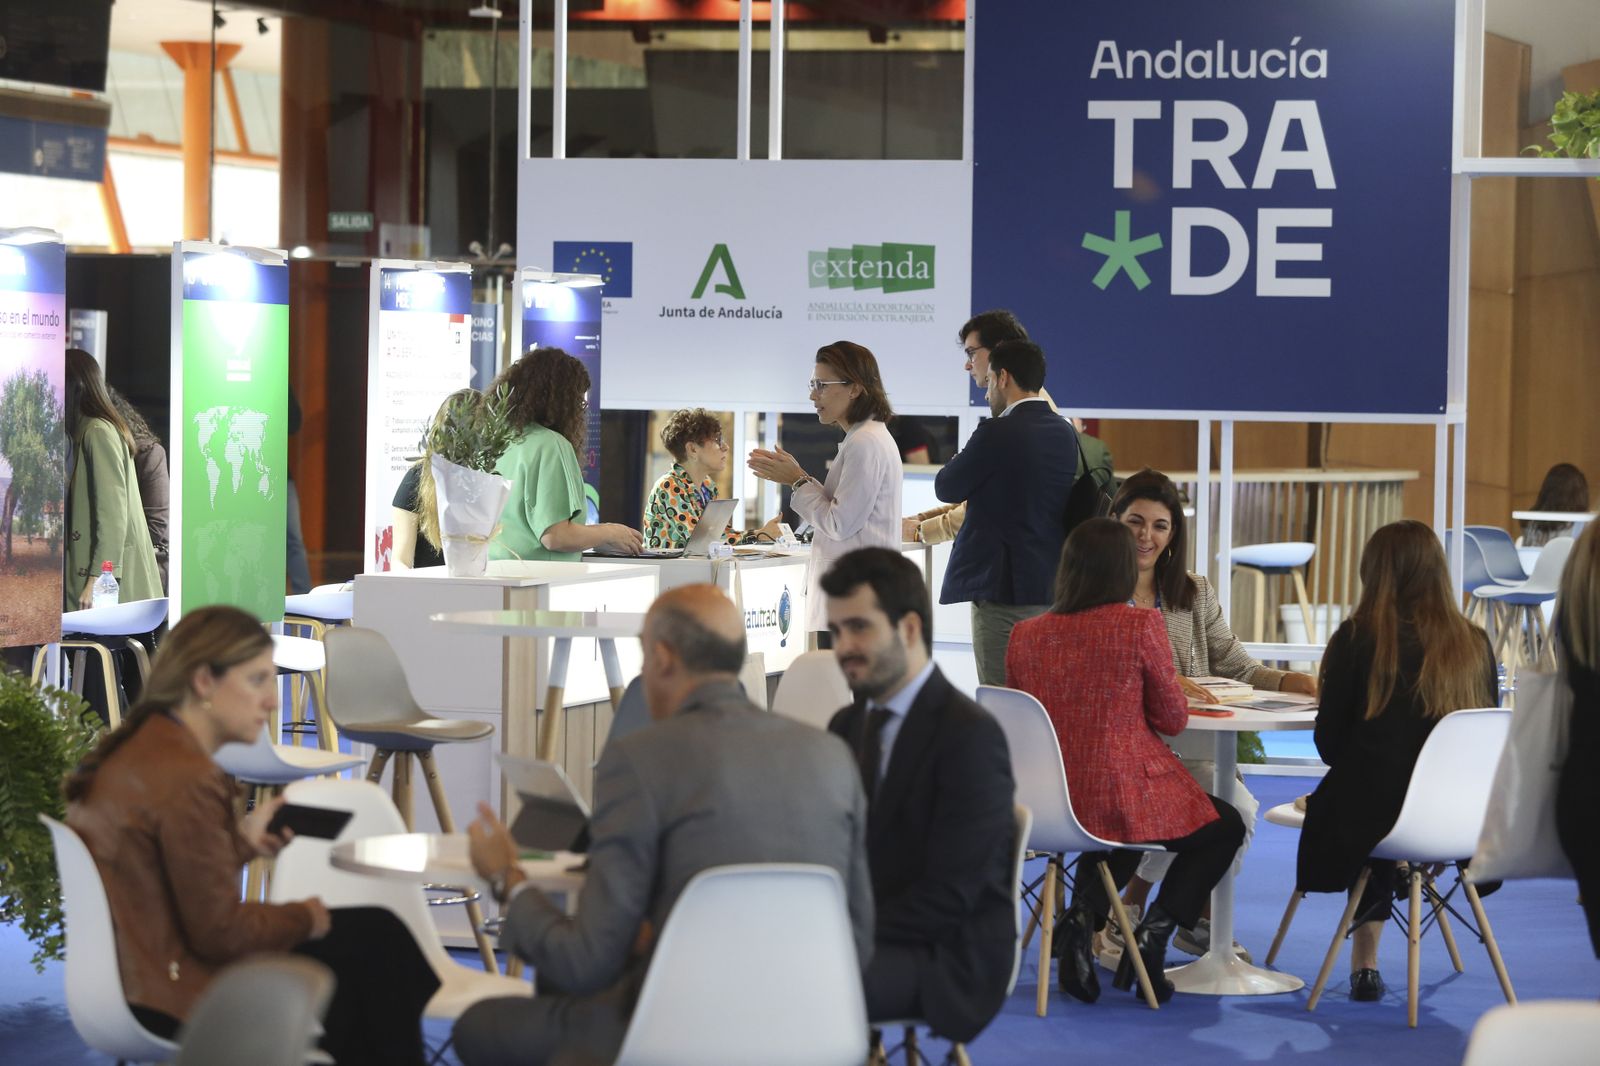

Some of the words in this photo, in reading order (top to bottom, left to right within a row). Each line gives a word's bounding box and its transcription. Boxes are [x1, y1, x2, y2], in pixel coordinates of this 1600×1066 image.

[1090, 36, 1328, 80] Andalucía
[1087, 99, 1337, 190] TRA
[332, 214, 370, 229] SALIDA
[1170, 206, 1333, 298] DE
[811, 250, 930, 280] extenda
[10, 312, 21, 325] en
[22, 307, 30, 325] el
[31, 310, 60, 327] mundo
[659, 306, 696, 318] Junta
[699, 306, 716, 318] de
[718, 305, 783, 319] Andalucía
[807, 301, 863, 313] ANDALUCÍA
[865, 302, 936, 314] EXPORTACIÓN
